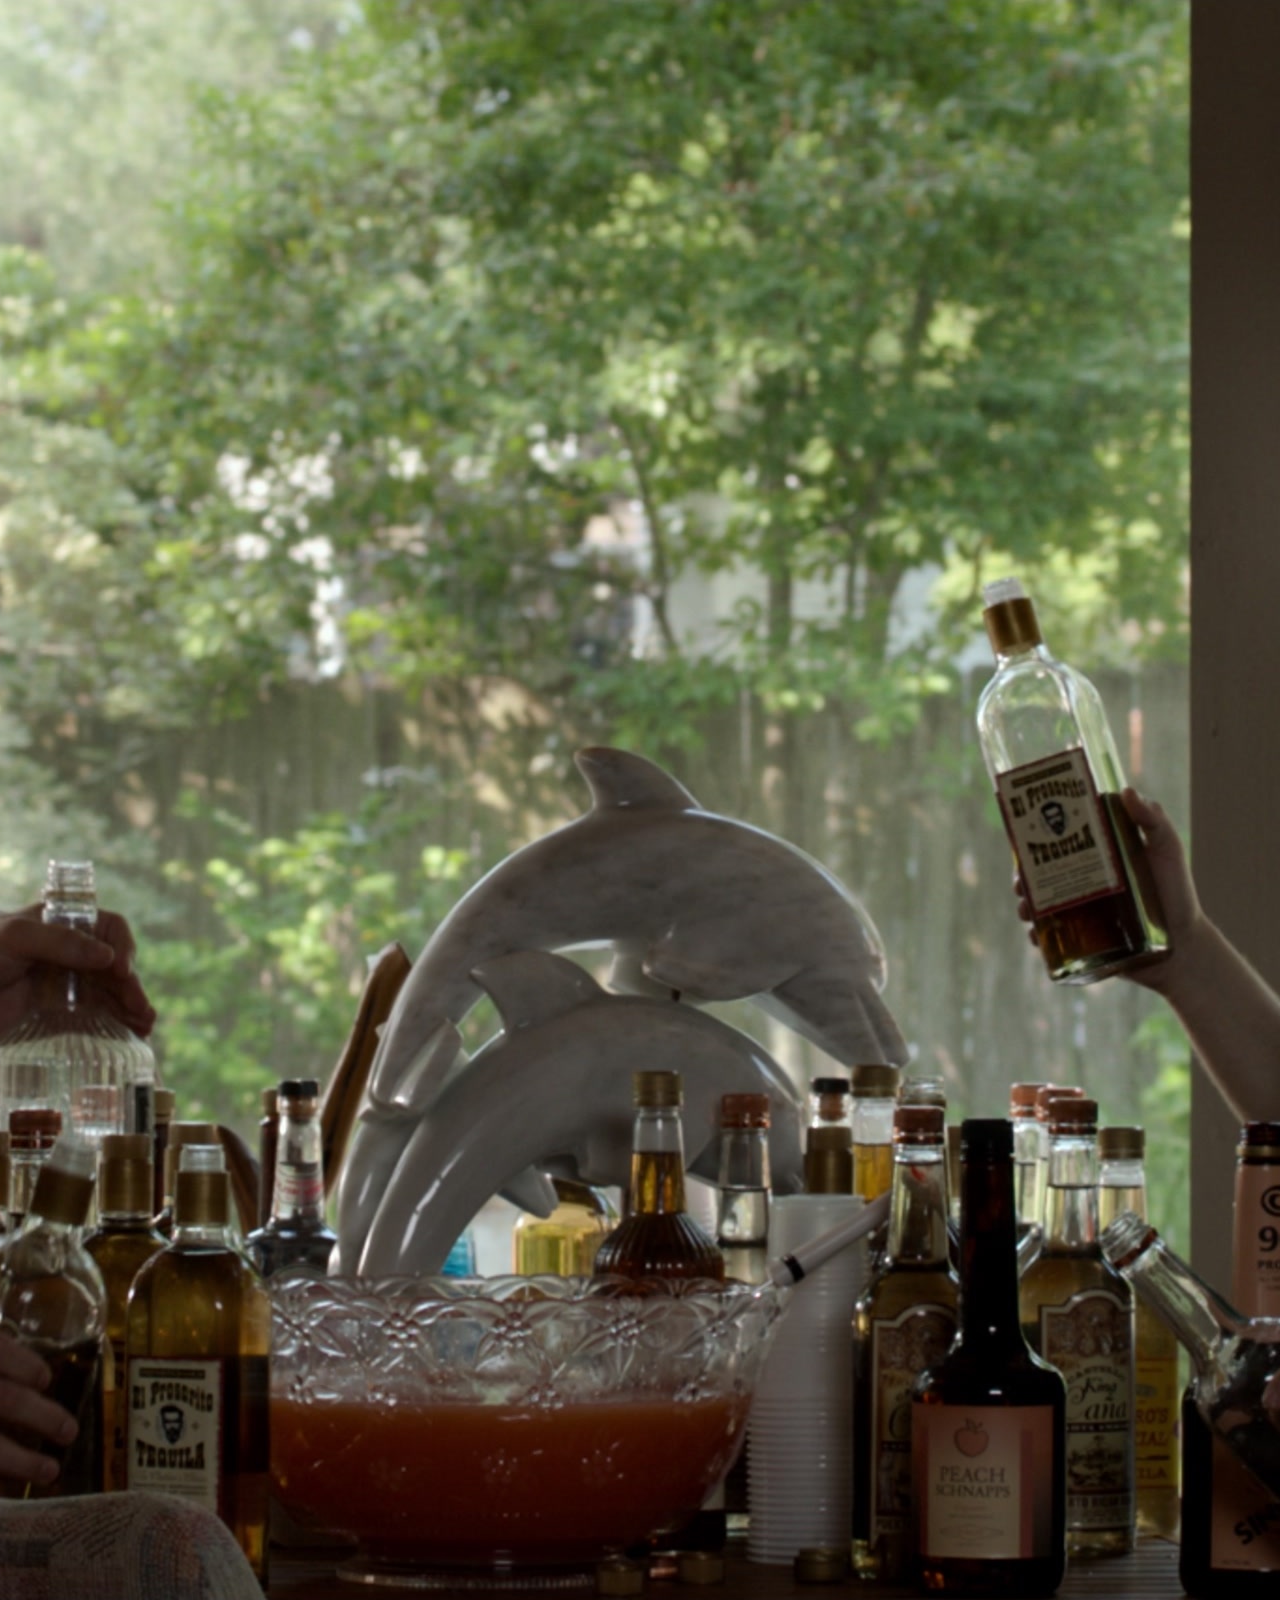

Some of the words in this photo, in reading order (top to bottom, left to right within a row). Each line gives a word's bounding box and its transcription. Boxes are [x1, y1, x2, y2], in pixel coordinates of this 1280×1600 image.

[1027, 822, 1096, 866] TEQUILA
[135, 1438, 205, 1469] TEQUILA
[939, 1465, 1005, 1483] PEACH
[935, 1484, 1011, 1498] SCHNAPPS
